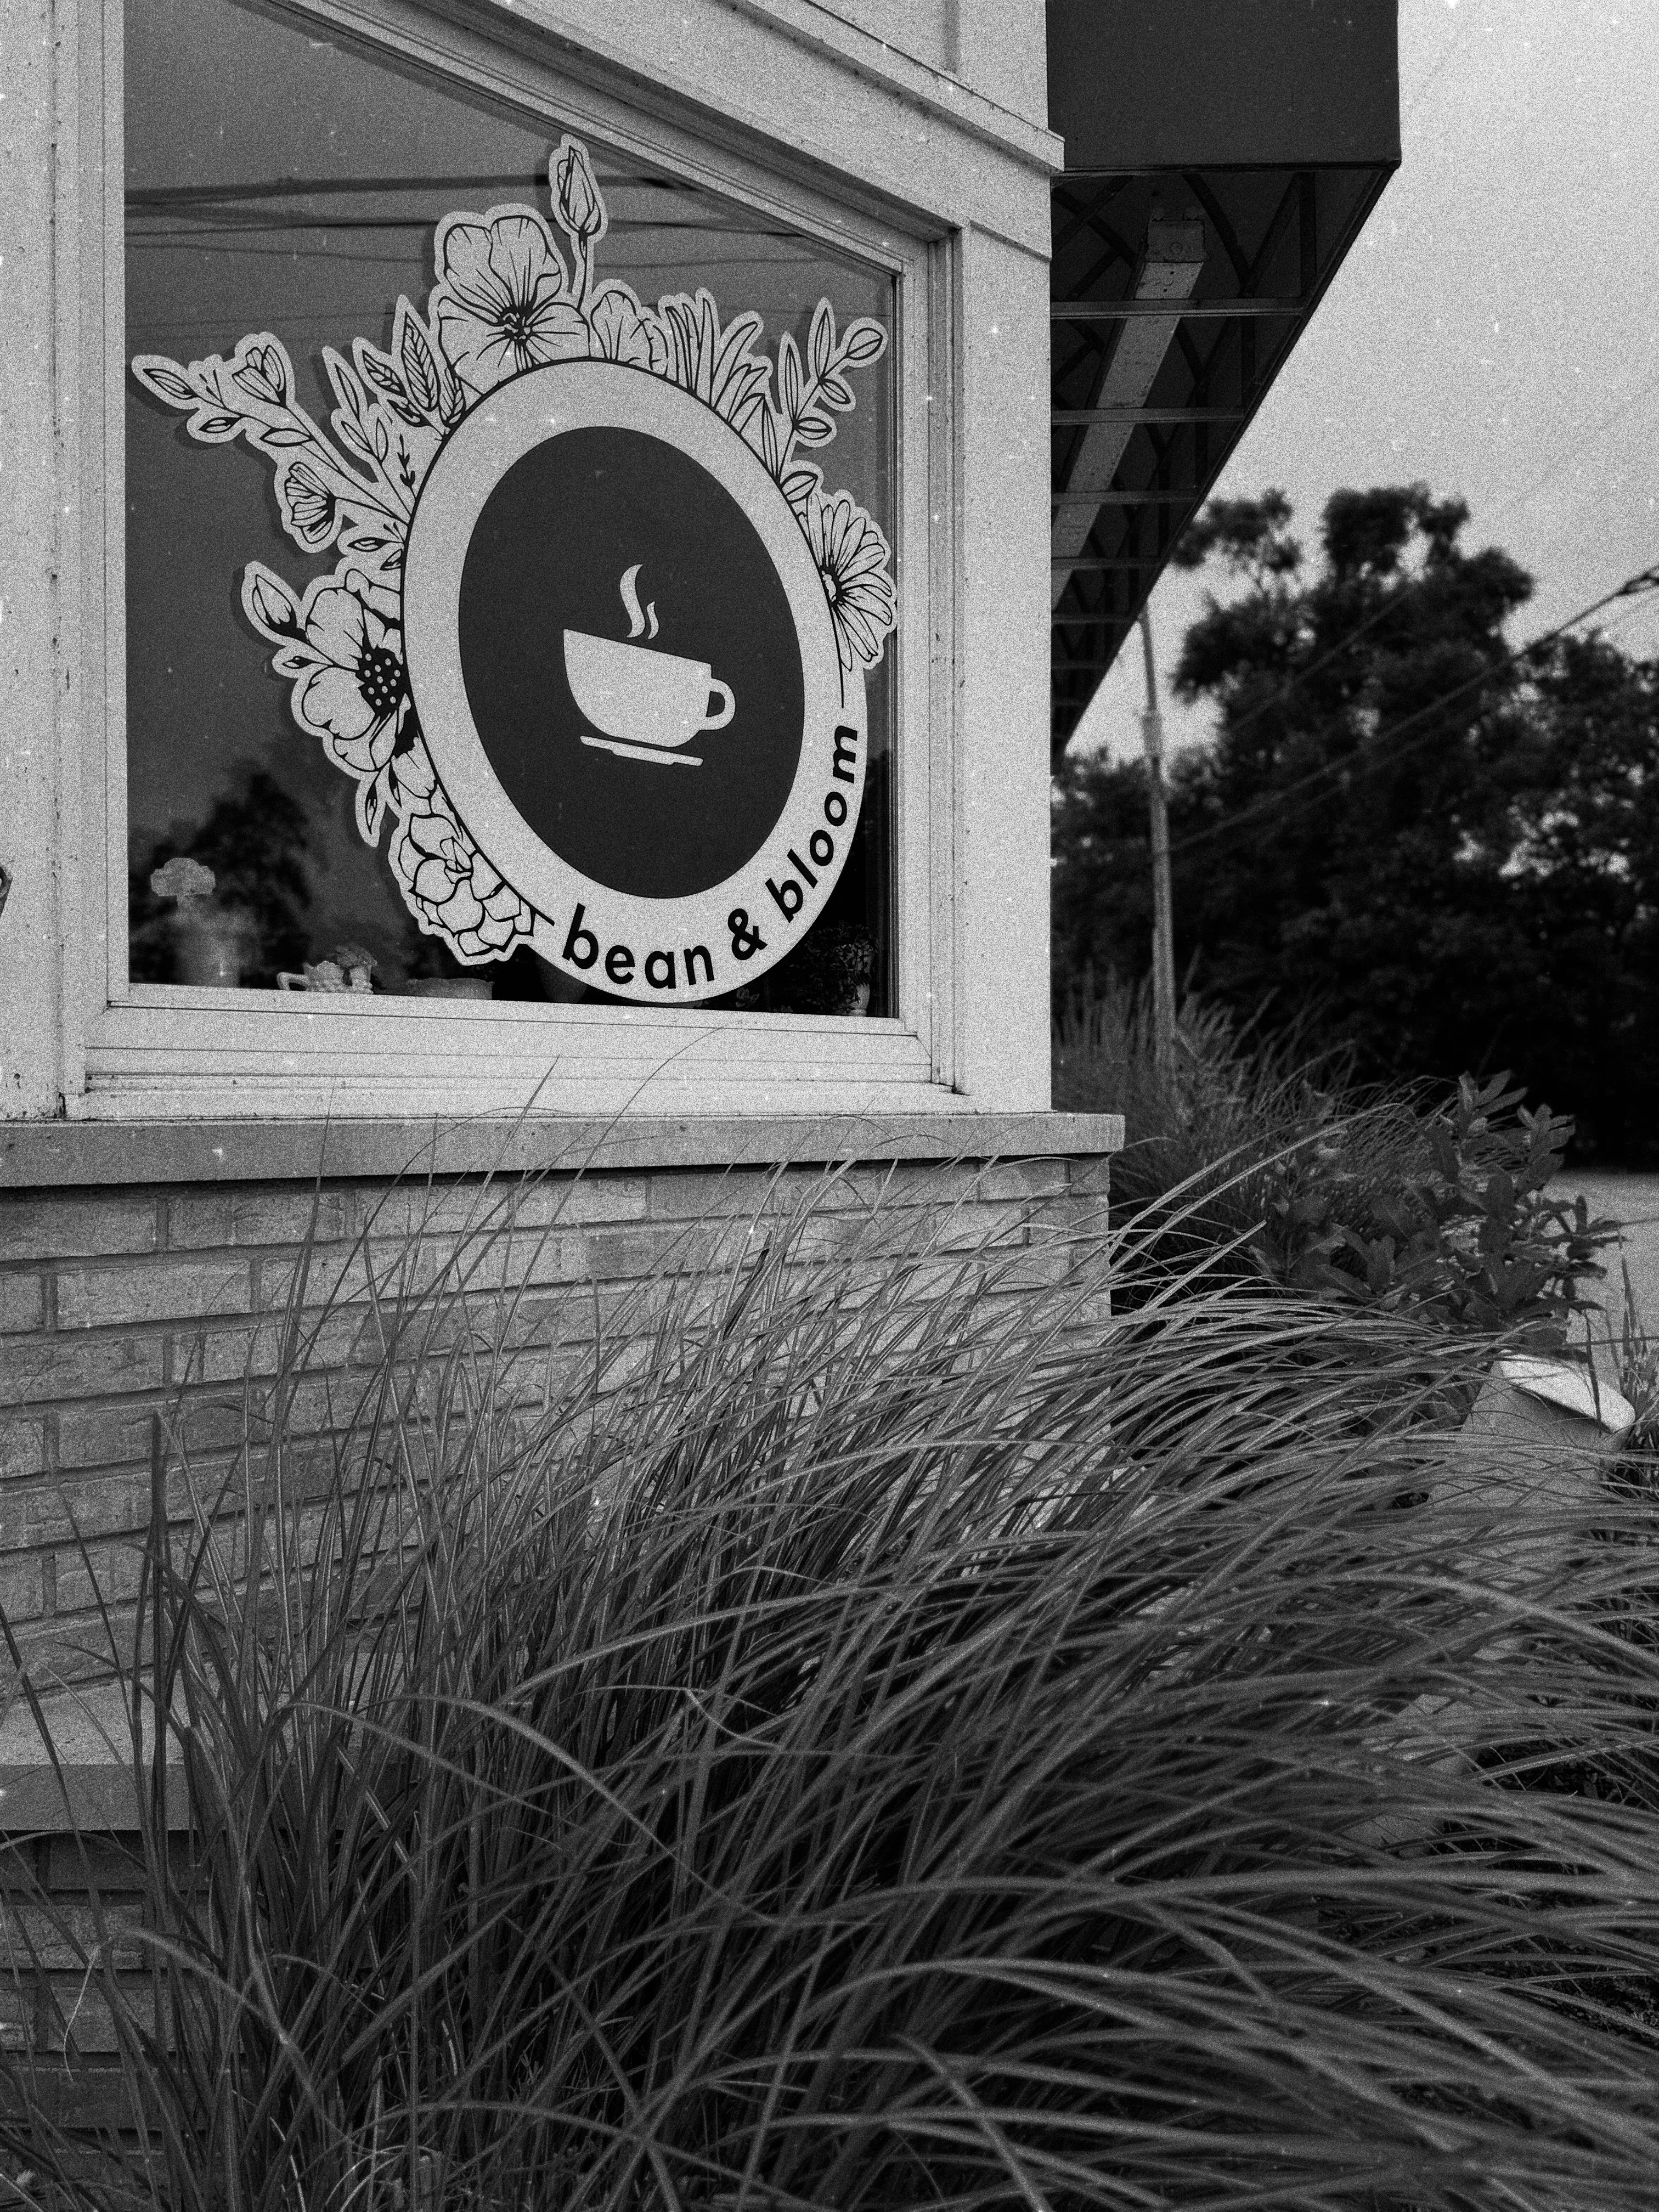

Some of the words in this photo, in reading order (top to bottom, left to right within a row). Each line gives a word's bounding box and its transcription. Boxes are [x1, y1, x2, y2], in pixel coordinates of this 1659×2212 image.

[562, 903, 714, 989] bean
[728, 909, 768, 960] &
[765, 726, 857, 922] bloom
